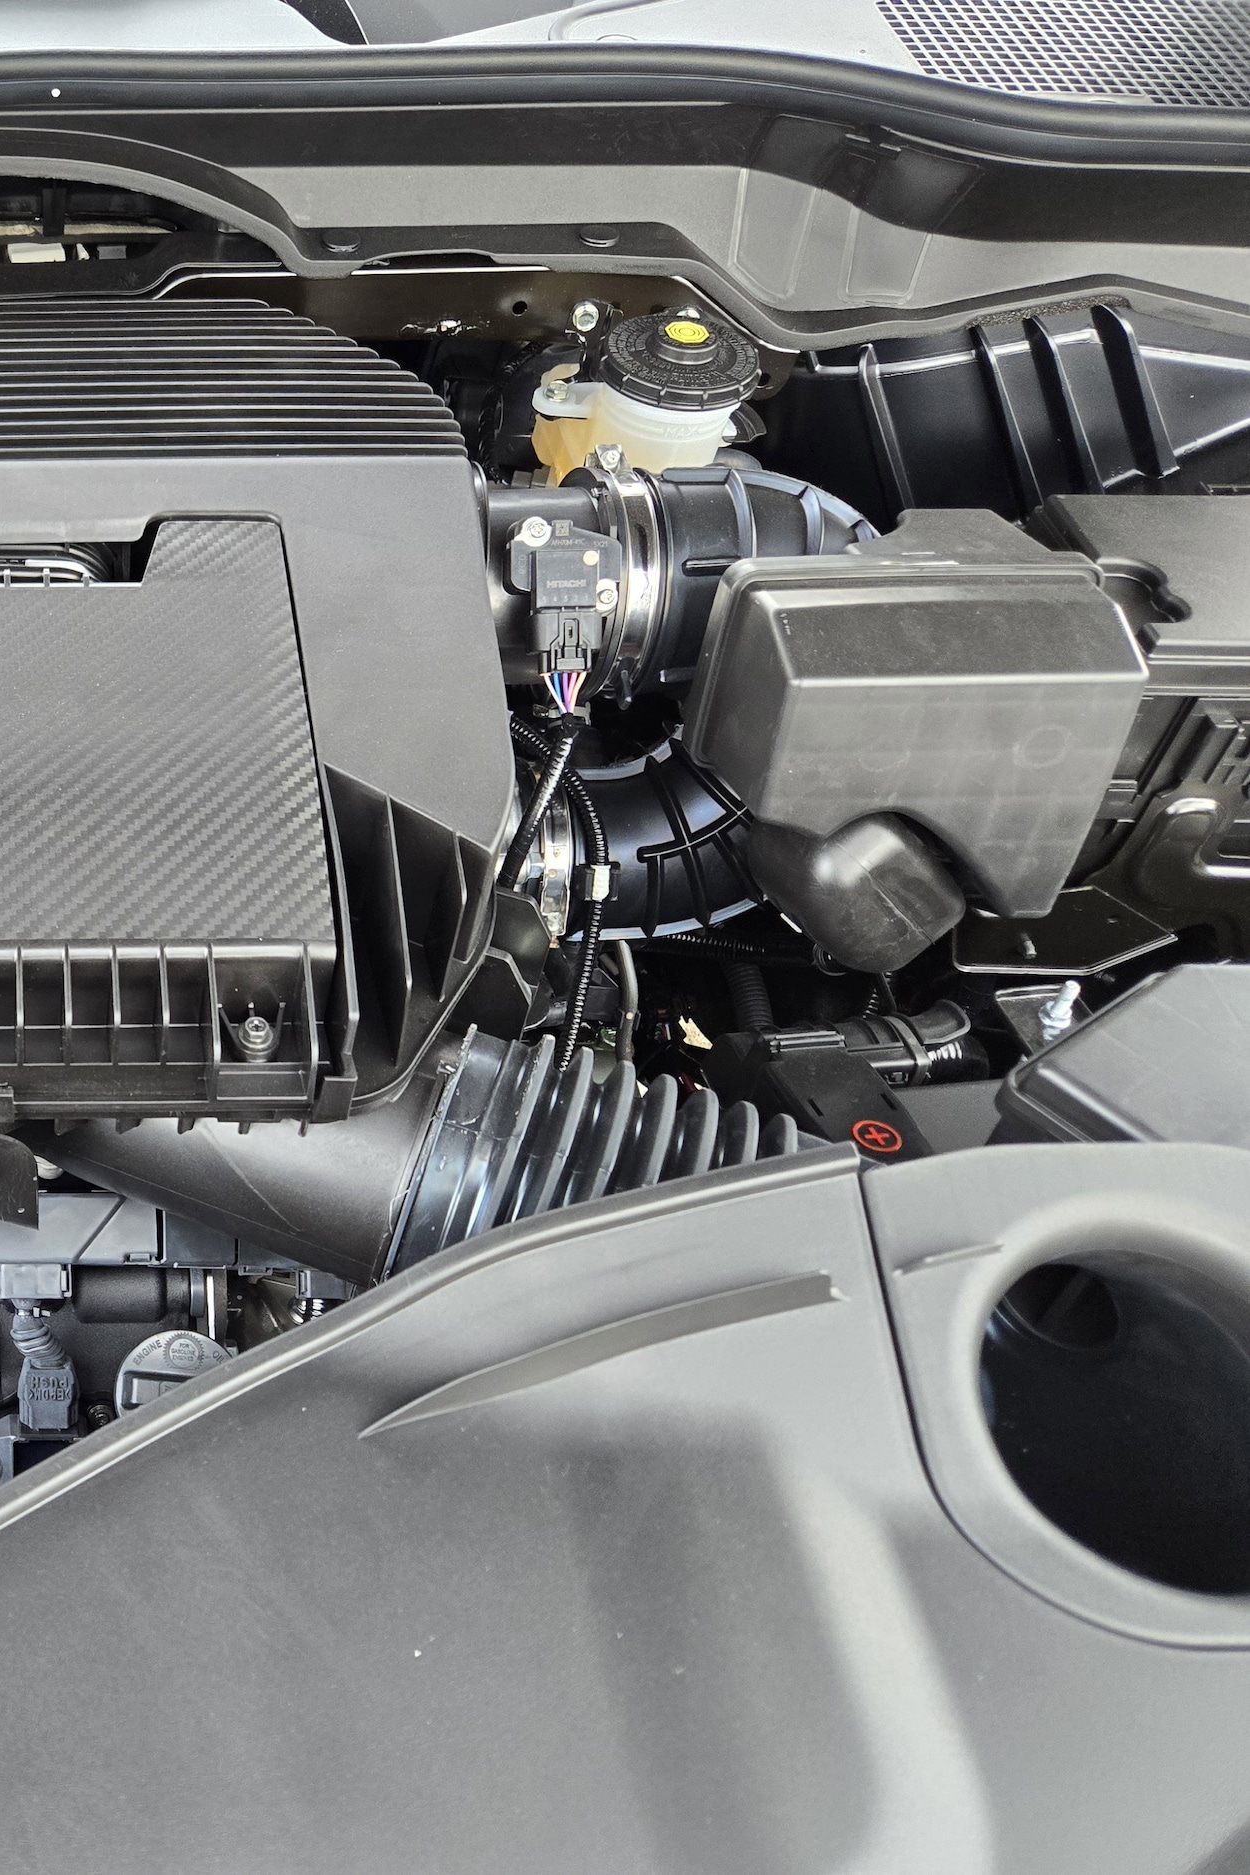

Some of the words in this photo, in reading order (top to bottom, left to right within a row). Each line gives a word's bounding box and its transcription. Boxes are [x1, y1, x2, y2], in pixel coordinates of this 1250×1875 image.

[664, 425, 699, 439] MAX
[546, 579, 587, 588] HITACHI
[132, 1339, 163, 1366] ENGINE
[212, 1350, 225, 1365] OIL
[170, 1347, 196, 1356] GASOLINE
[30, 1376, 69, 1388] PUSH
